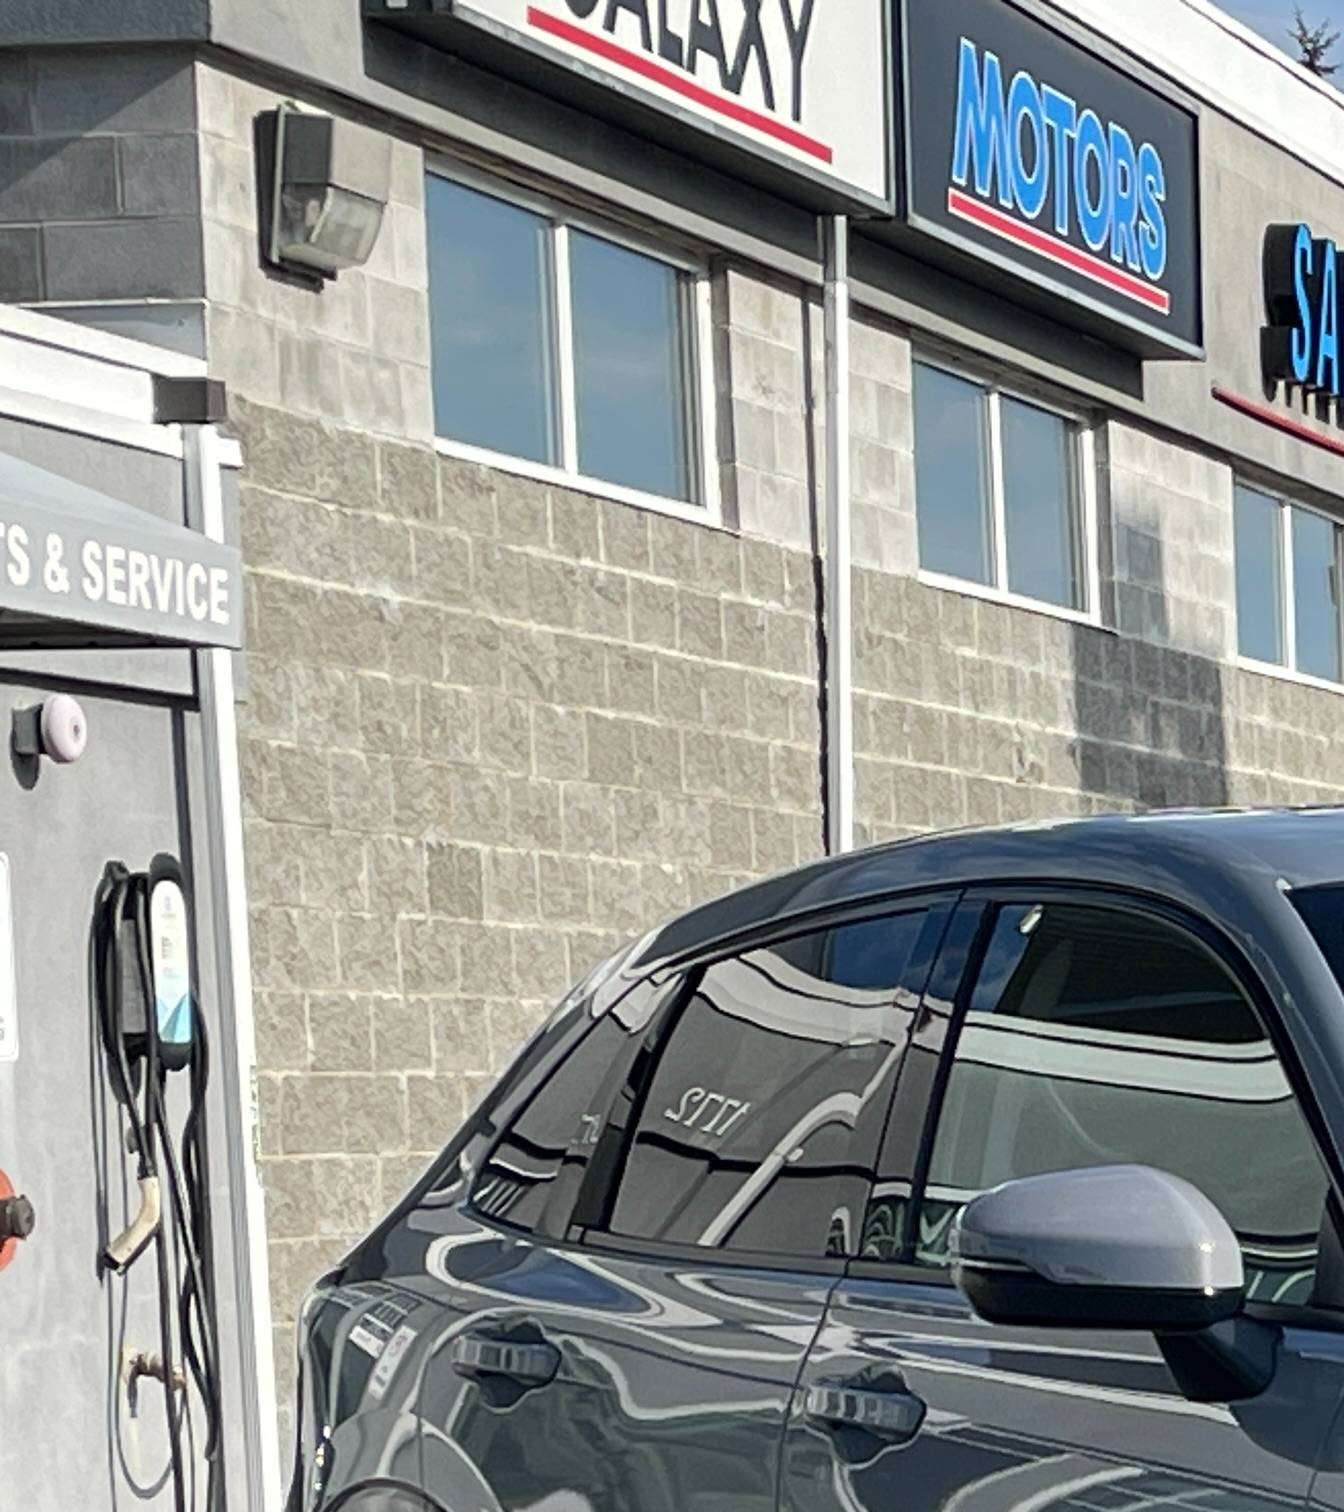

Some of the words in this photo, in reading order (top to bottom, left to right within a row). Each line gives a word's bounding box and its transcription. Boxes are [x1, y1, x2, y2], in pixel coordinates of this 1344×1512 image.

[565, 0, 815, 122] AXY
[952, 36, 1166, 281] MOTORS
[0, 523, 31, 587] S
[43, 532, 71, 594] &
[81, 540, 230, 626] SERVICE
